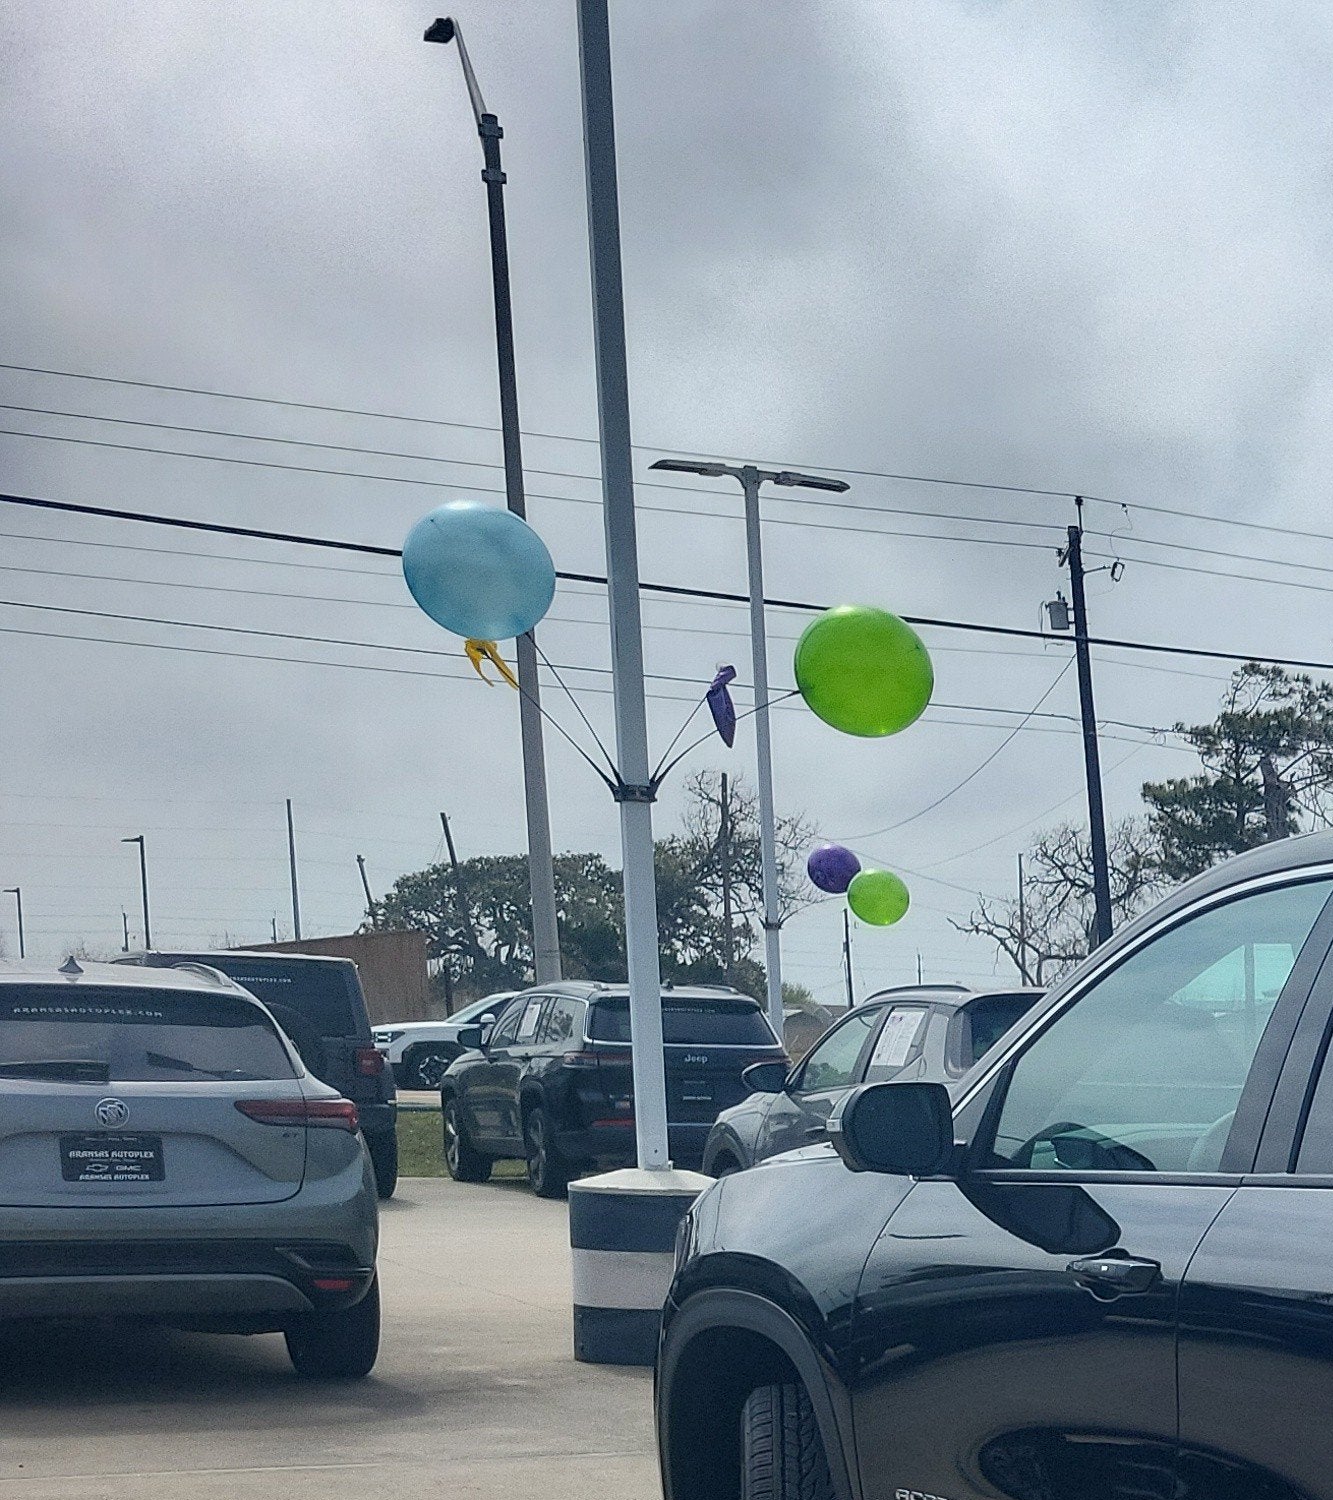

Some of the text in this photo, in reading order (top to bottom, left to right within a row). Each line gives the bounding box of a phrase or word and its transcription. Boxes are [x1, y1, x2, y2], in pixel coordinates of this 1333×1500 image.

[684, 1054, 708, 1063] Jeep
[69, 1150, 155, 1159] ARANSAS AUTOPLEX
